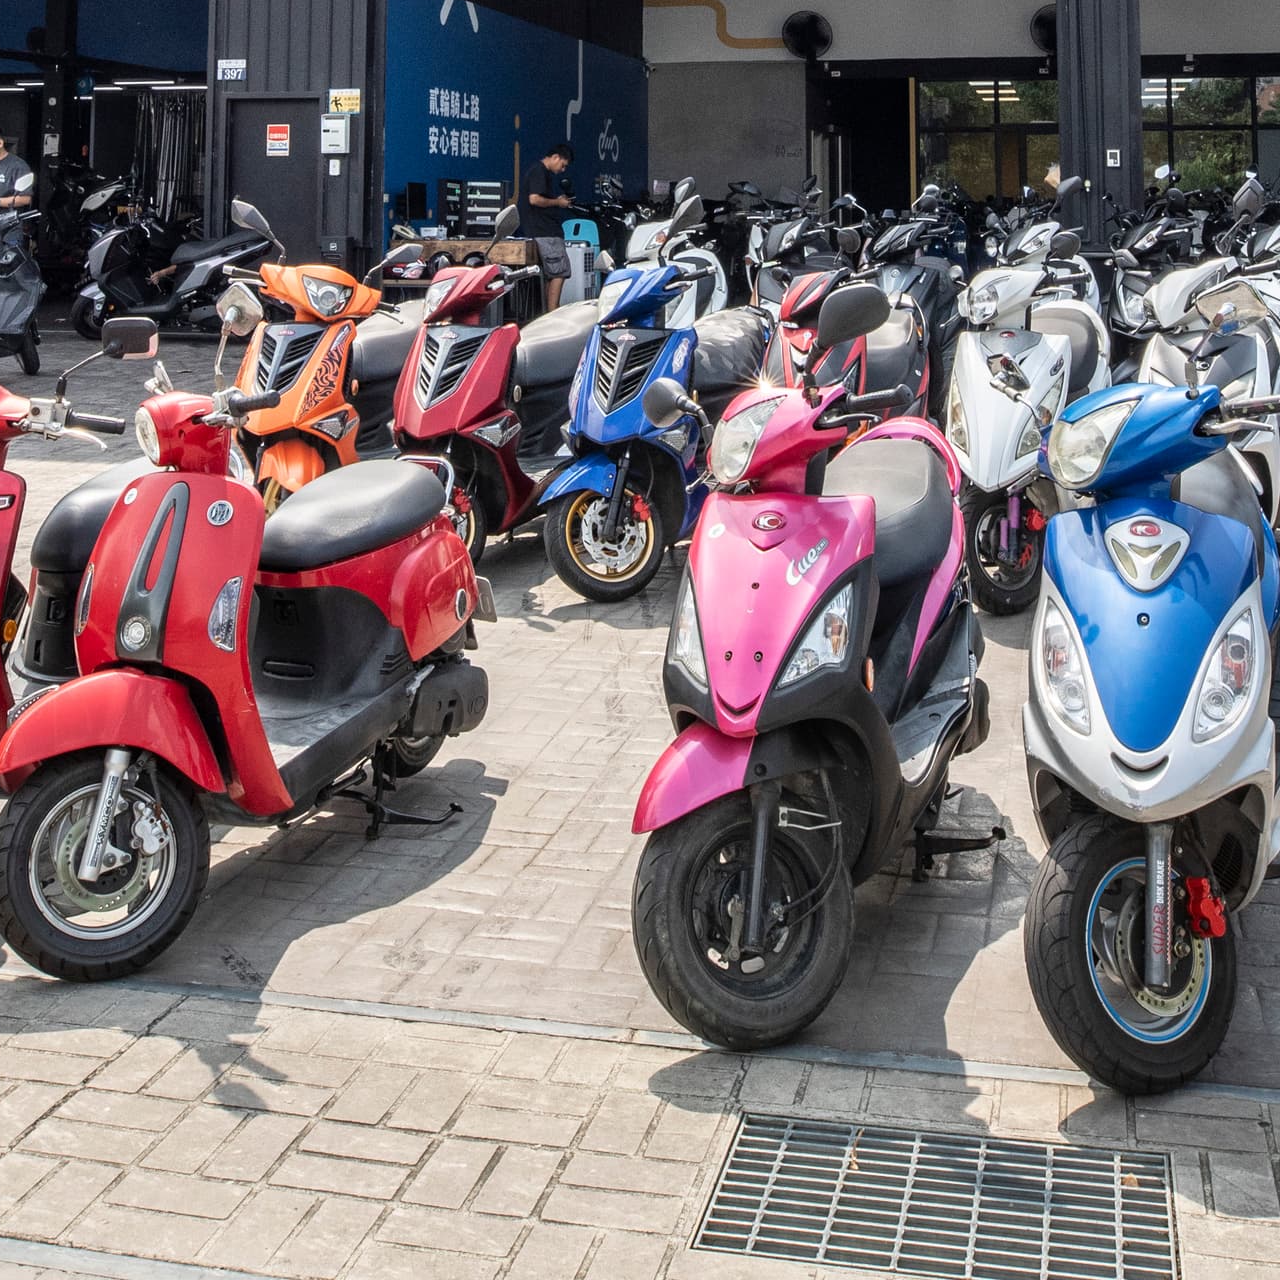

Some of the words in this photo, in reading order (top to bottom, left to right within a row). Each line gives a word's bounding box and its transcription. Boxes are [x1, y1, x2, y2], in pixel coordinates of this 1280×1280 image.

[224, 68, 243, 80] 397
[429, 87, 480, 122] 貳輪騎上路
[429, 126, 480, 159] 安心有保固
[786, 547, 819, 587] Cue
[95, 797, 114, 845] KYMCO
[1156, 859, 1165, 885] BRAKE
[1156, 887, 1165, 904] DISK
[1152, 905, 1166, 955] SUPER
